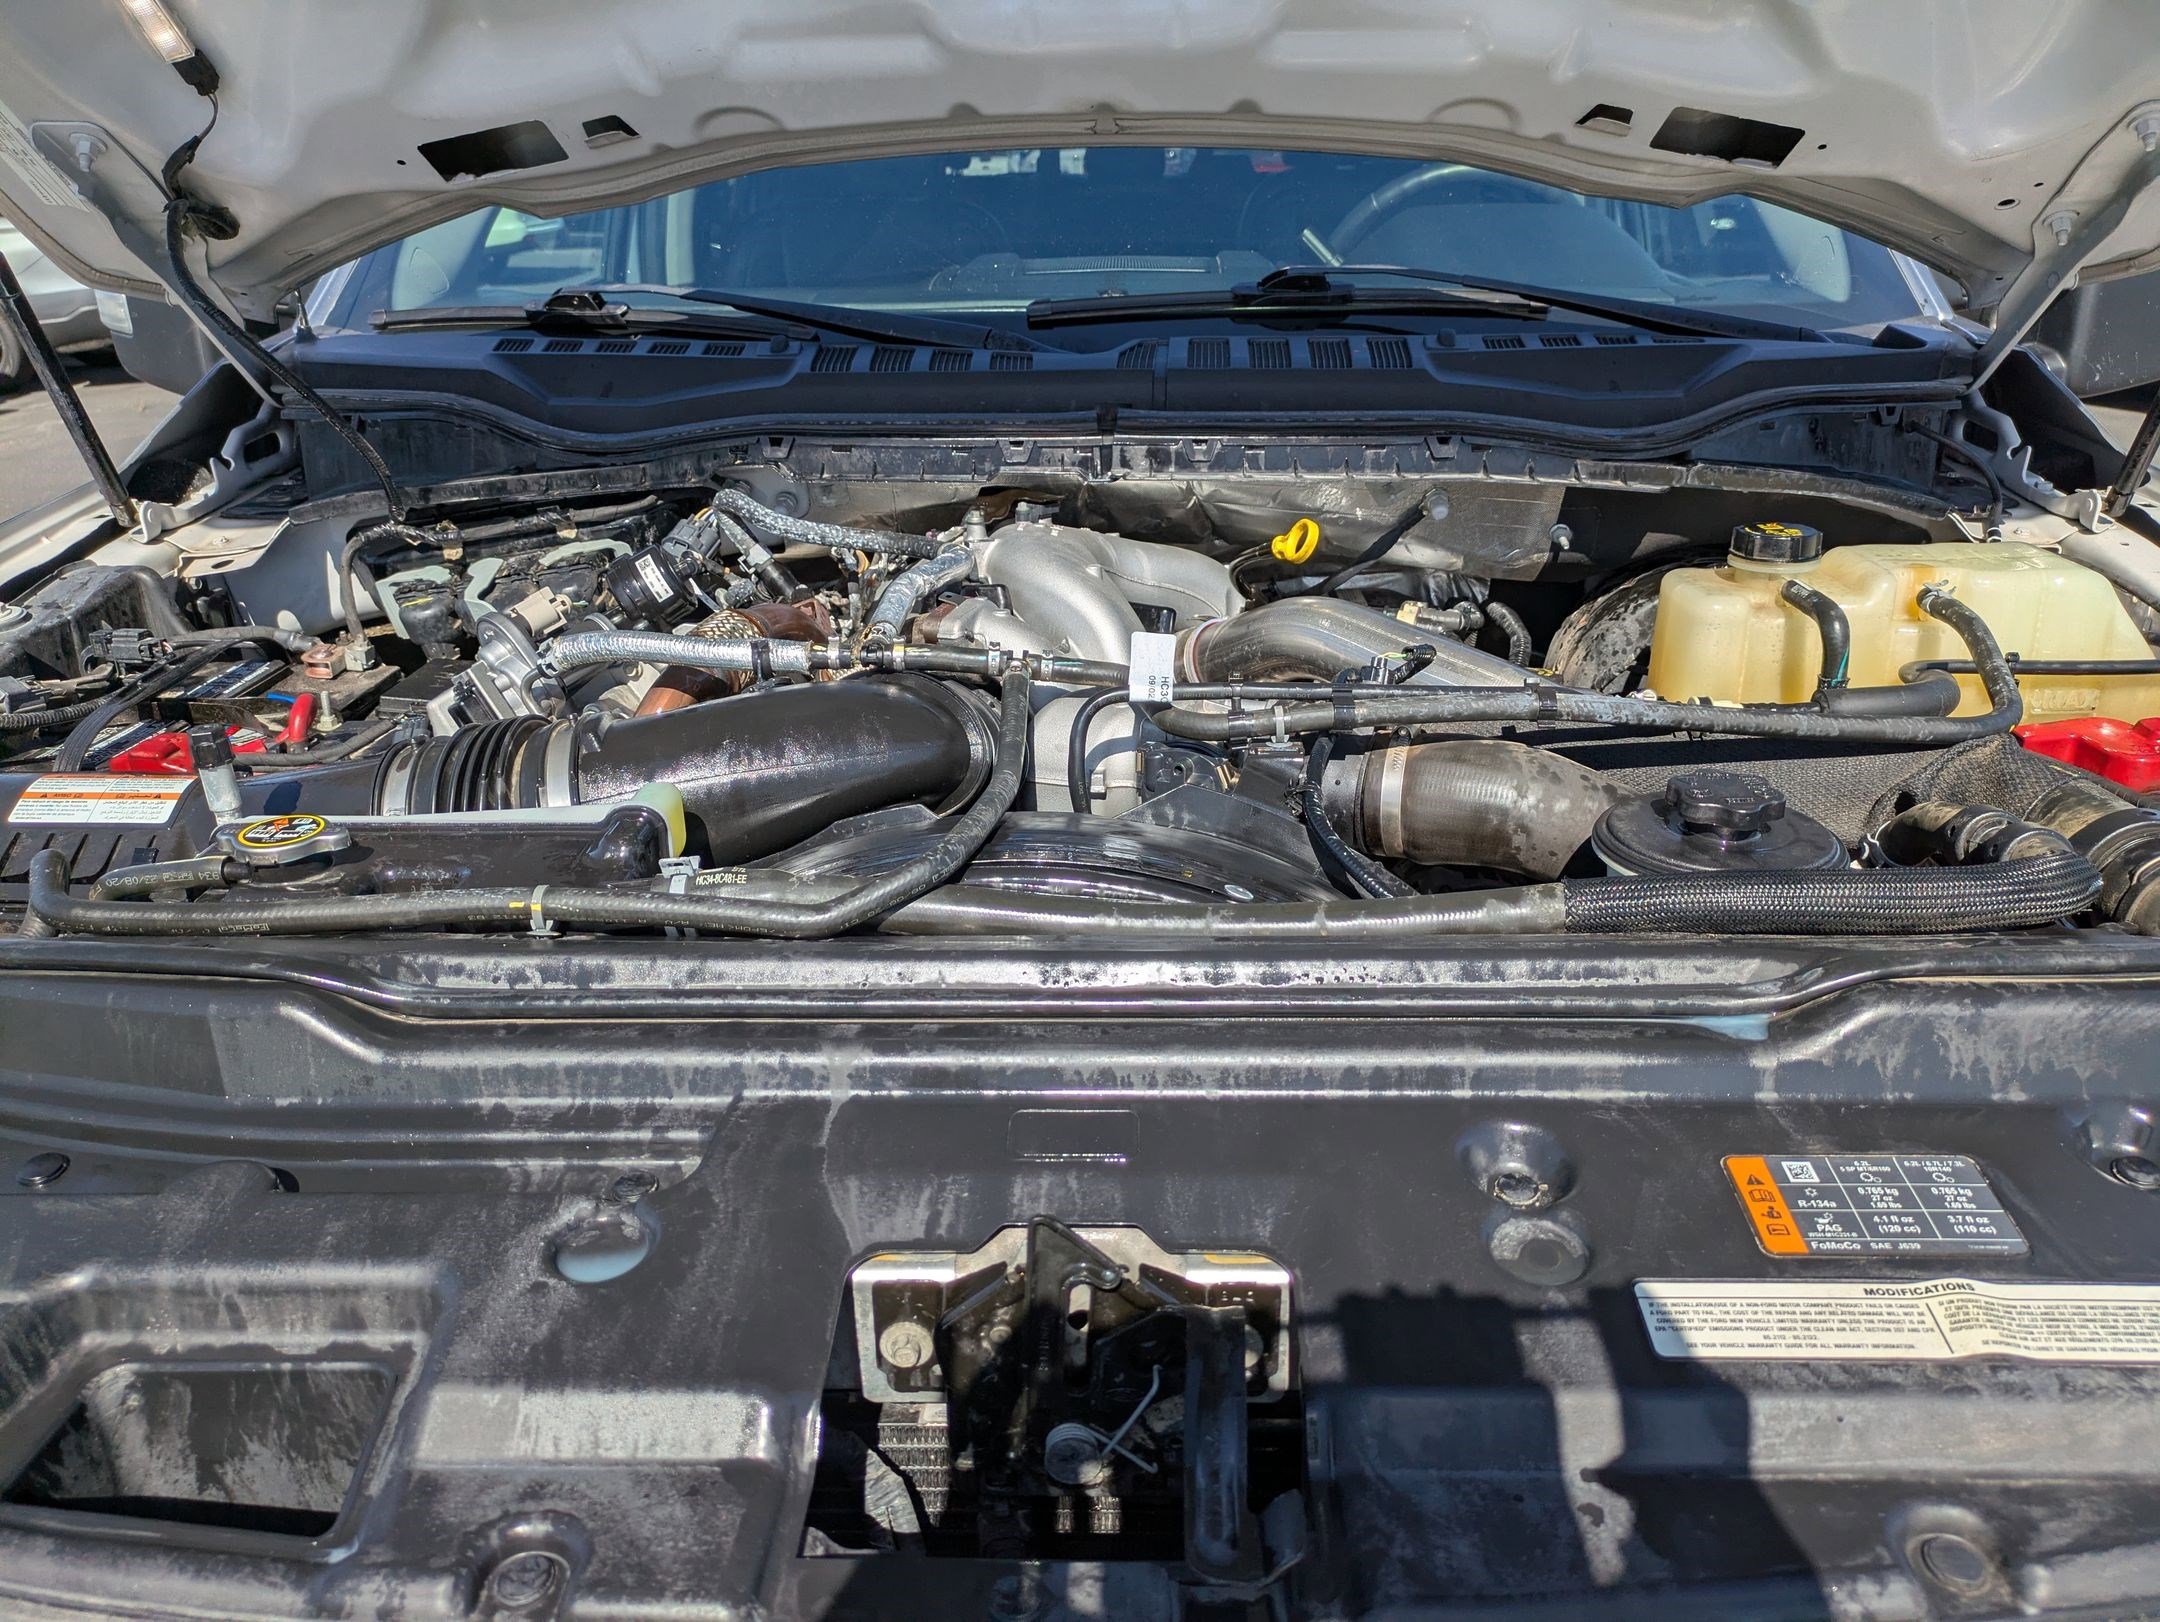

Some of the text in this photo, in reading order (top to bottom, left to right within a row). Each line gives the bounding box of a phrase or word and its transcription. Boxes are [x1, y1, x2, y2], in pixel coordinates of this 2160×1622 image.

[1857, 1187, 1899, 1196] 0.765 kg
[1930, 1187, 1973, 1197] 0.765 kg
[1797, 1200, 1837, 1208] R-134a
[1873, 1215, 1888, 1223] 4.1
[1890, 1215, 1899, 1223] fl
[1947, 1215, 1962, 1223] 3.7
[1965, 1215, 1974, 1223] fl
[1816, 1224, 1842, 1232] PAG
[1878, 1225, 1921, 1234] (120 cc)
[1953, 1225, 1997, 1235] (110 cc)
[1810, 1241, 1861, 1250] FoMoCo
[1864, 1282, 1976, 1296] MODIFICATIONS
